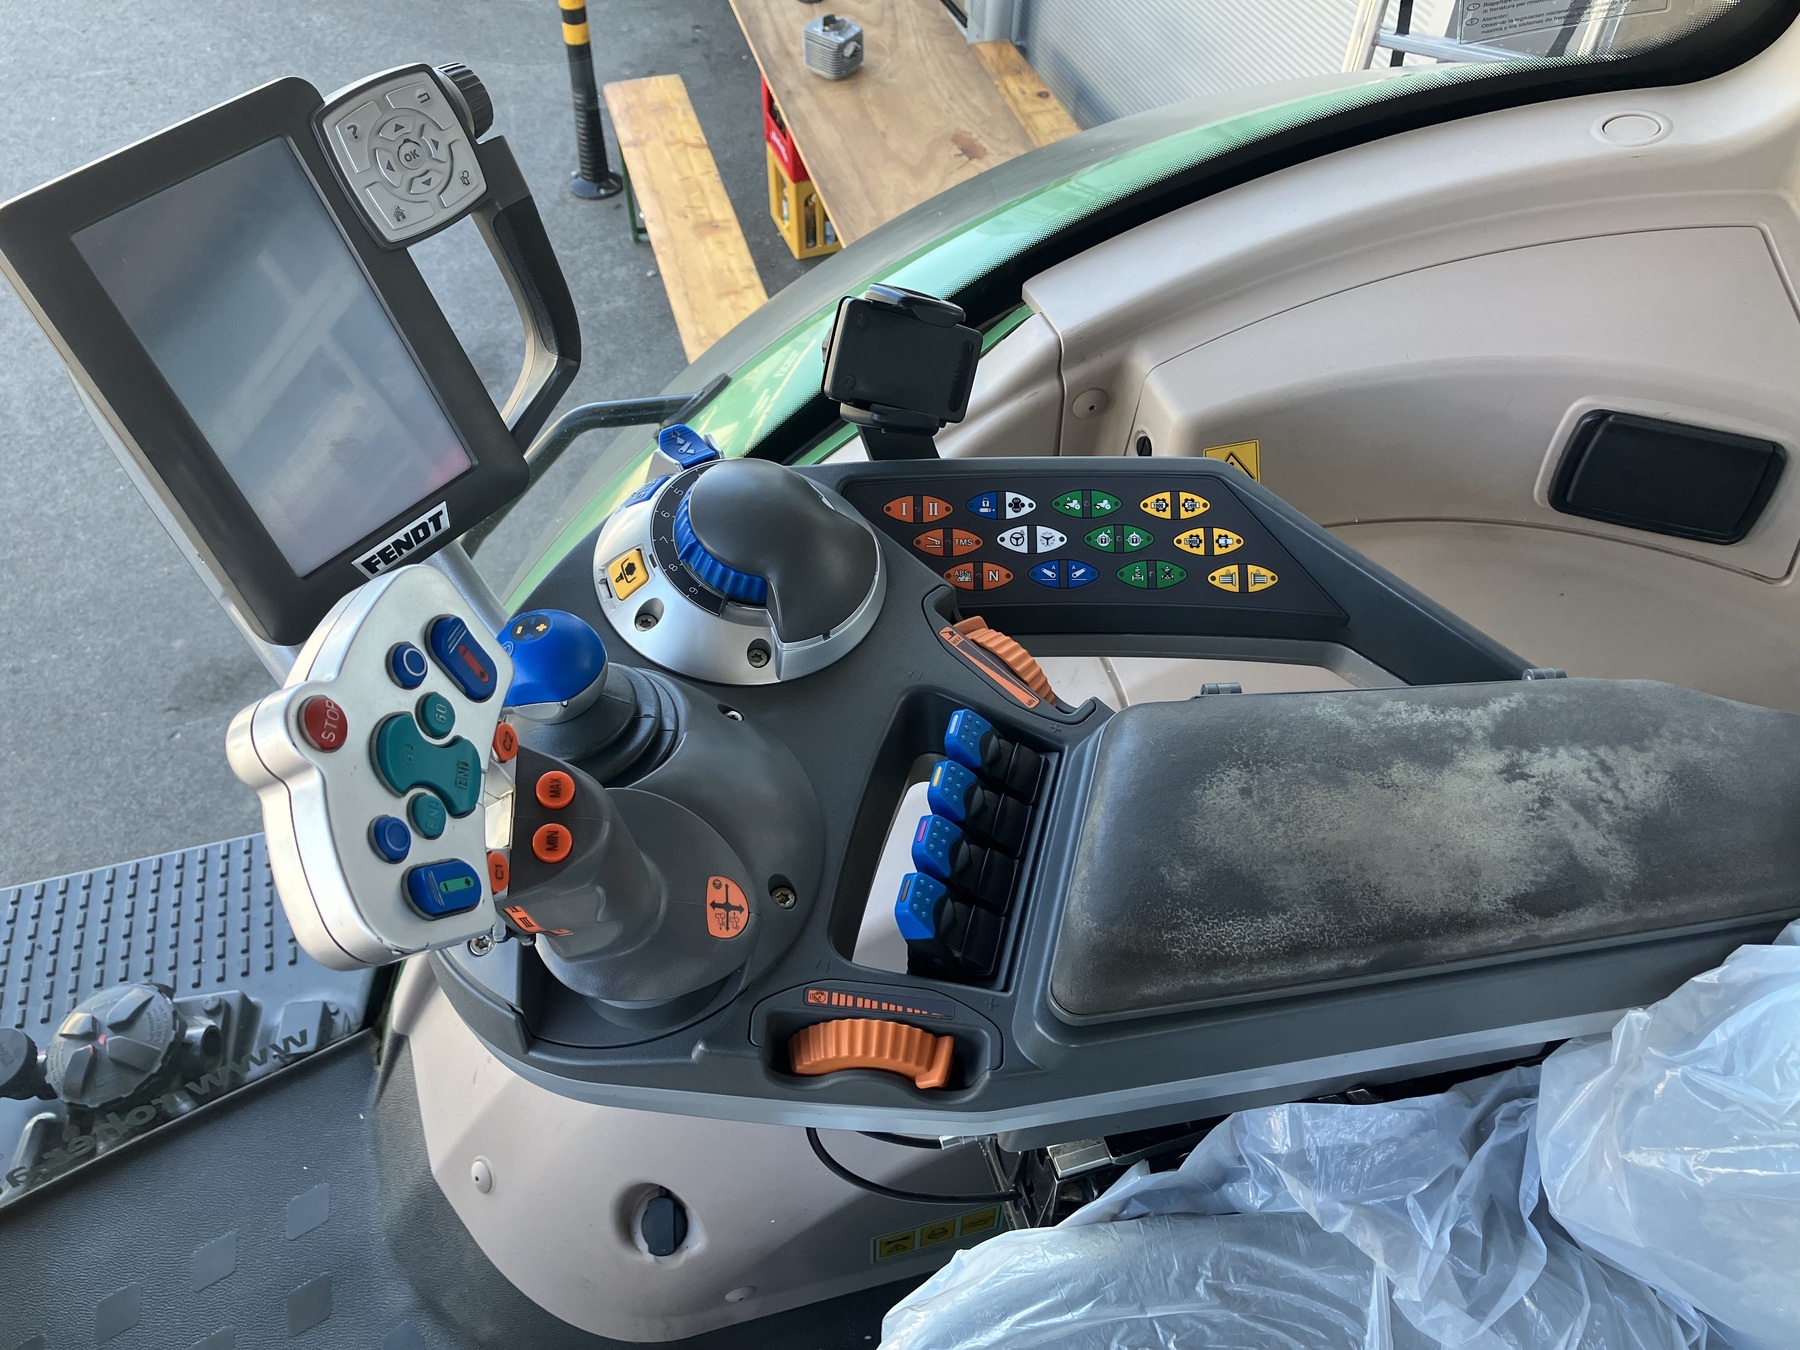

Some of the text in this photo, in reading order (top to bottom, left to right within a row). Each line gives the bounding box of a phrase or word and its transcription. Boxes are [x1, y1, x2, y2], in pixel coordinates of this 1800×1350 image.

[404, 149, 420, 162] OK
[673, 487, 684, 496] 5
[660, 510, 671, 518] 6
[361, 509, 444, 575] FENDT
[659, 535, 669, 544] 7
[954, 538, 973, 546] TMS
[668, 563, 679, 573] 8
[989, 570, 999, 582] N
[688, 586, 699, 595] 9
[321, 699, 341, 742] STOP
[435, 703, 447, 723] GO
[503, 730, 514, 751] C2
[455, 759, 470, 789] END
[549, 777, 562, 799] MAX
[545, 830, 559, 852] MIN
[495, 863, 504, 880] C1
